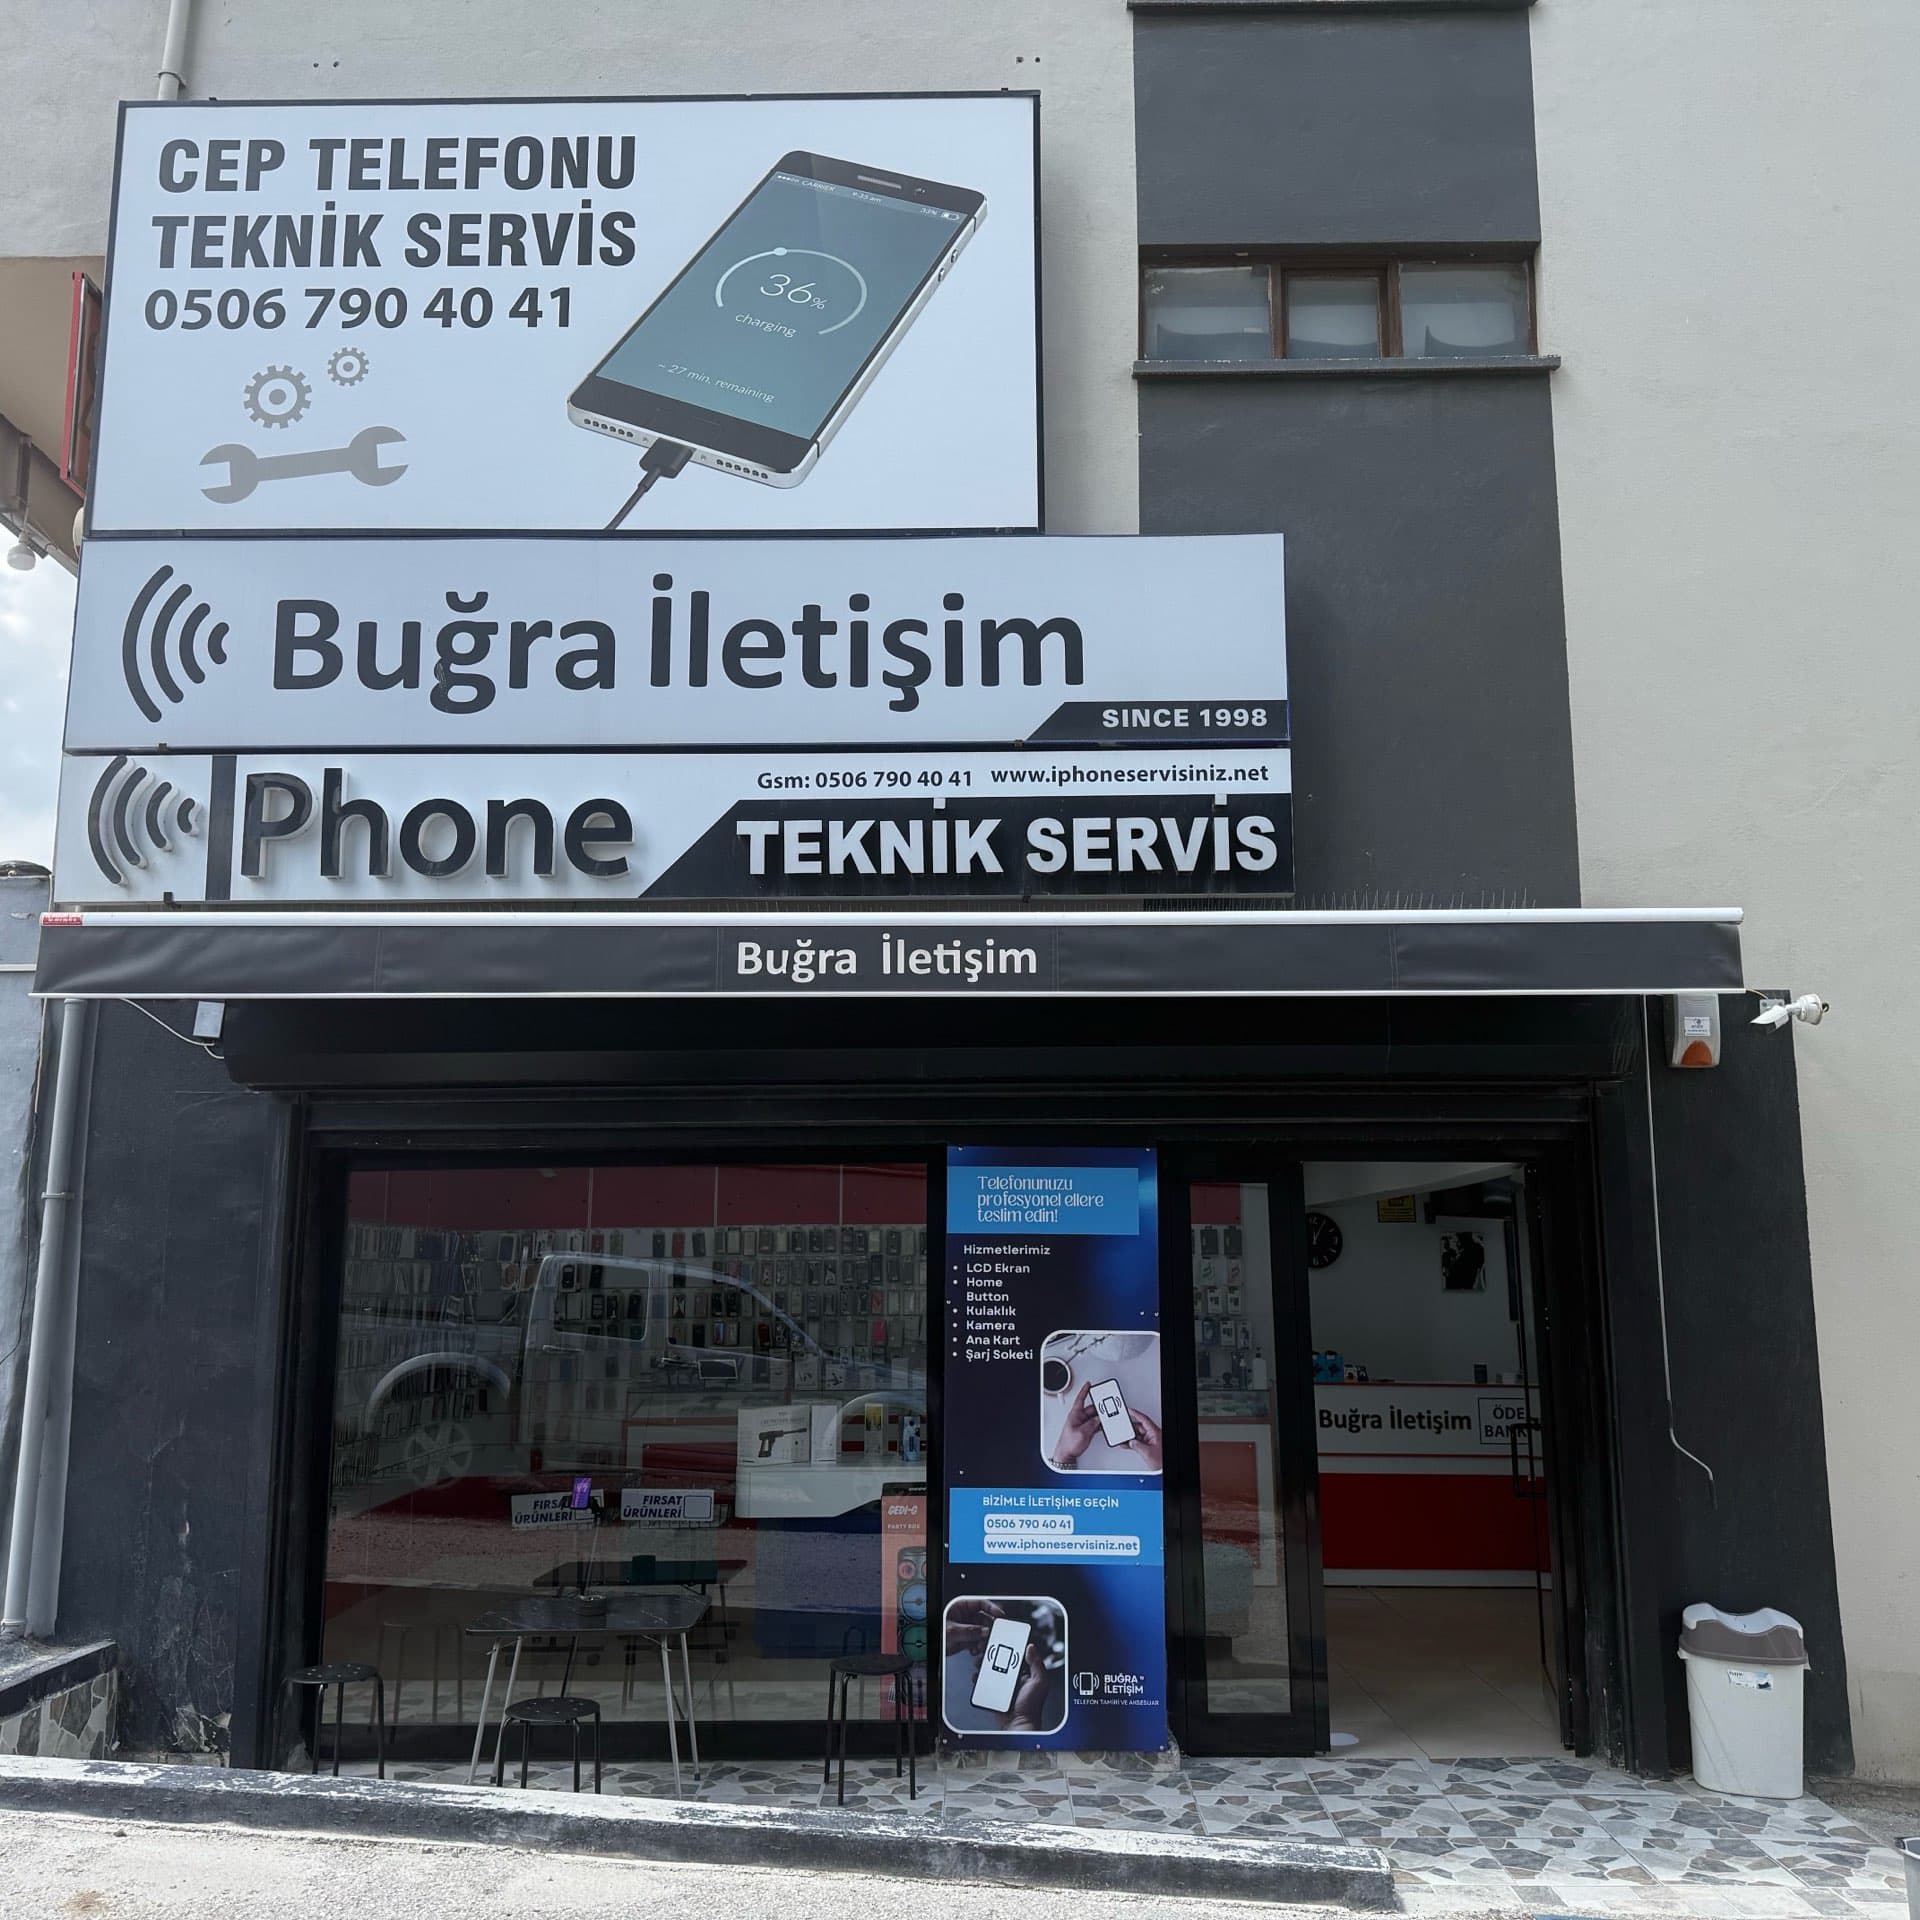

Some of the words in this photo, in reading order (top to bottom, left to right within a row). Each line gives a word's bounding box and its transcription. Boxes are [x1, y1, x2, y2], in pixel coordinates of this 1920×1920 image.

[157, 138, 286, 193] CEP
[309, 135, 636, 192] TELEFONU
[151, 200, 385, 269] TEKNİK
[404, 198, 637, 268] SERVİS
[760, 273, 828, 310] 36%
[144, 287, 287, 331] 0506
[304, 286, 408, 330] 790
[423, 286, 494, 329] 40
[508, 285, 572, 329] 41
[735, 311, 798, 339] charging
[667, 364, 687, 376] 27
[687, 370, 711, 385] min.
[714, 378, 775, 404] remaining
[272, 590, 616, 715] Buğra
[650, 572, 1085, 713] İletişim
[1101, 706, 1190, 728] SINCE
[1198, 706, 1269, 728] 1998
[757, 771, 811, 790] Gsm:
[815, 771, 868, 789] 0506
[873, 770, 912, 788] 790
[917, 770, 945, 787] 40
[948, 769, 972, 787] 41
[990, 765, 1269, 785] www.iphoneservisiniz.net
[736, 797, 1003, 875] TEKNİK
[1025, 793, 1278, 874] SERVİS
[737, 938, 857, 983] Buğra
[881, 933, 1038, 984] İletişim
[977, 1174, 1073, 1190] Telefonunuzu
[977, 1191, 1061, 1209] profesyonel
[1064, 1193, 1104, 1207] ellere
[977, 1207, 1022, 1223] teslim
[1024, 1208, 1058, 1223] edin!
[963, 1244, 1051, 1255] Hizmetlerimiz
[966, 1263, 992, 1274] LCD
[995, 1263, 1031, 1274] Ekran
[966, 1277, 1003, 1288] Home
[966, 1291, 1009, 1302] Button
[966, 1305, 1016, 1317] Kulaklık
[966, 1320, 1016, 1331] Kamera
[966, 1335, 991, 1346] Ana
[993, 1335, 1021, 1346] Kart
[966, 1348, 991, 1362] Şarj
[993, 1348, 1034, 1361] Soketi
[1318, 1408, 1383, 1434] Buğra
[1388, 1404, 1472, 1435] İletişim
[642, 1495, 684, 1506] FIRSAT
[982, 1494, 1026, 1507] BİZİMLE
[1028, 1494, 1081, 1510] İLETİŞİME
[1083, 1496, 1119, 1511] GEÇİN
[623, 1506, 683, 1519] ÜRÜNLERİ
[986, 1518, 1016, 1529] 0506
[1019, 1519, 1040, 1529] 790
[1042, 1519, 1057, 1529] 40
[1059, 1519, 1072, 1530] 41
[986, 1538, 1138, 1551] www.iphoneservisiniz.net
[1104, 1673, 1138, 1684] BUĞRA
[1104, 1683, 1144, 1697] İLETİŞİM
